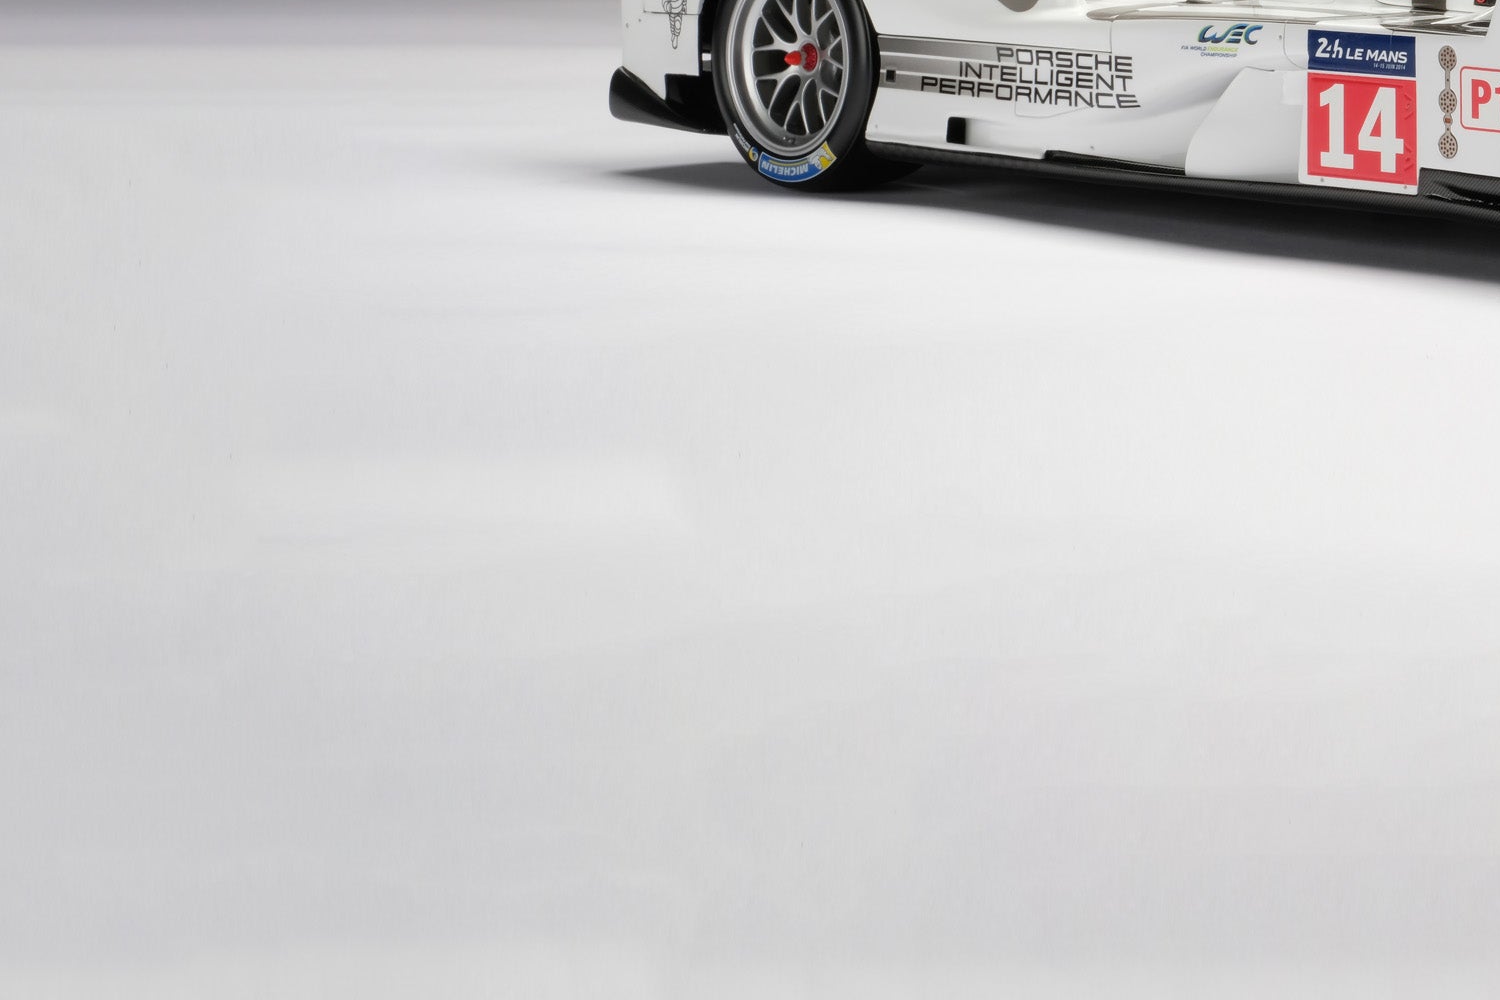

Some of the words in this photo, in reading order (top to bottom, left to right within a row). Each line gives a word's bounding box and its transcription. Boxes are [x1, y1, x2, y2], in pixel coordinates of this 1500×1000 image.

[1197, 22, 1263, 46] WEC
[996, 46, 1133, 73] PORSCHE
[1345, 48, 1364, 61] LE
[1365, 49, 1408, 63] MANS
[959, 61, 1133, 92] INTELLIGENT
[921, 76, 1141, 109] PERFORMANCE
[1319, 83, 1404, 173] 14
[761, 160, 809, 176] MICHELIN
